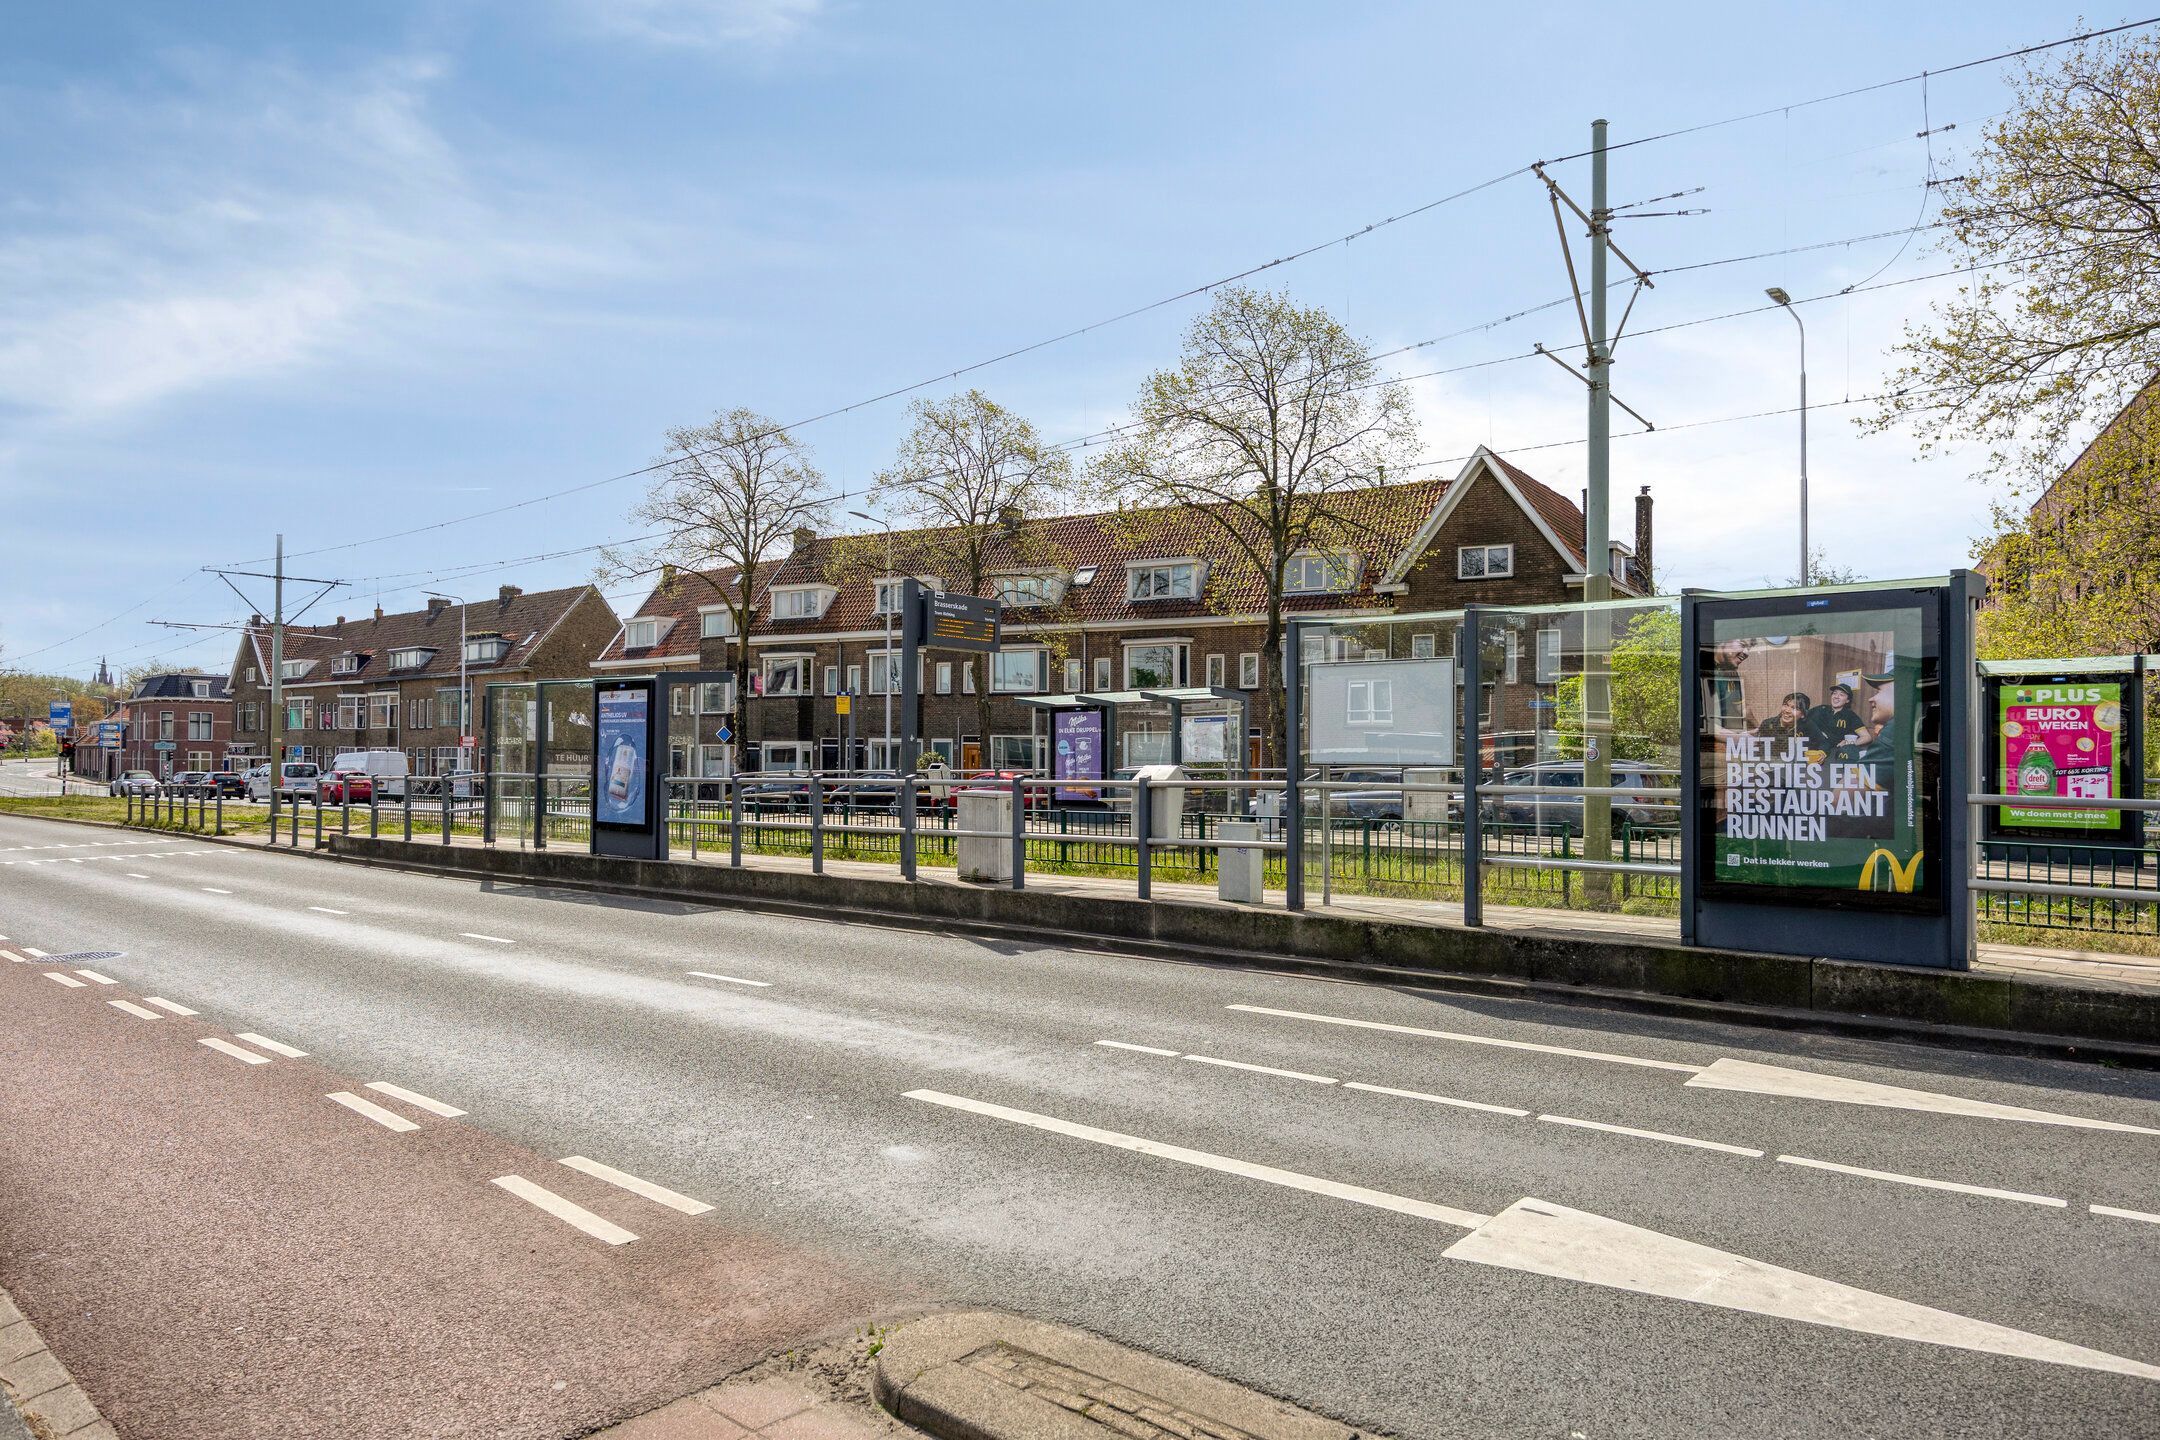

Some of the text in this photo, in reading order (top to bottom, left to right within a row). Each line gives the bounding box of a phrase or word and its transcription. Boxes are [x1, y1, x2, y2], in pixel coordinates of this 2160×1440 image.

[934, 600, 968, 611] Brasserskade
[2036, 688, 2101, 703] PLUS
[2026, 707, 2080, 720] EURO
[1069, 714, 1087, 727] Milka
[2038, 721, 2088, 730] WEKEN
[1725, 736, 1810, 762] MET JE
[555, 754, 589, 762] TE HUUR
[1727, 762, 1876, 790] BESTIES EEN
[2080, 766, 2108, 774] KORTING
[2028, 774, 2045, 783] dreft
[1726, 788, 1889, 817] RESTAURANT
[2010, 809, 2026, 817] We
[2026, 810, 2051, 818] doen
[2052, 811, 2072, 819] met
[2073, 811, 2083, 819] je
[1727, 814, 1826, 842] RUNNEN
[1743, 856, 1829, 868] Dat is lekker werken
